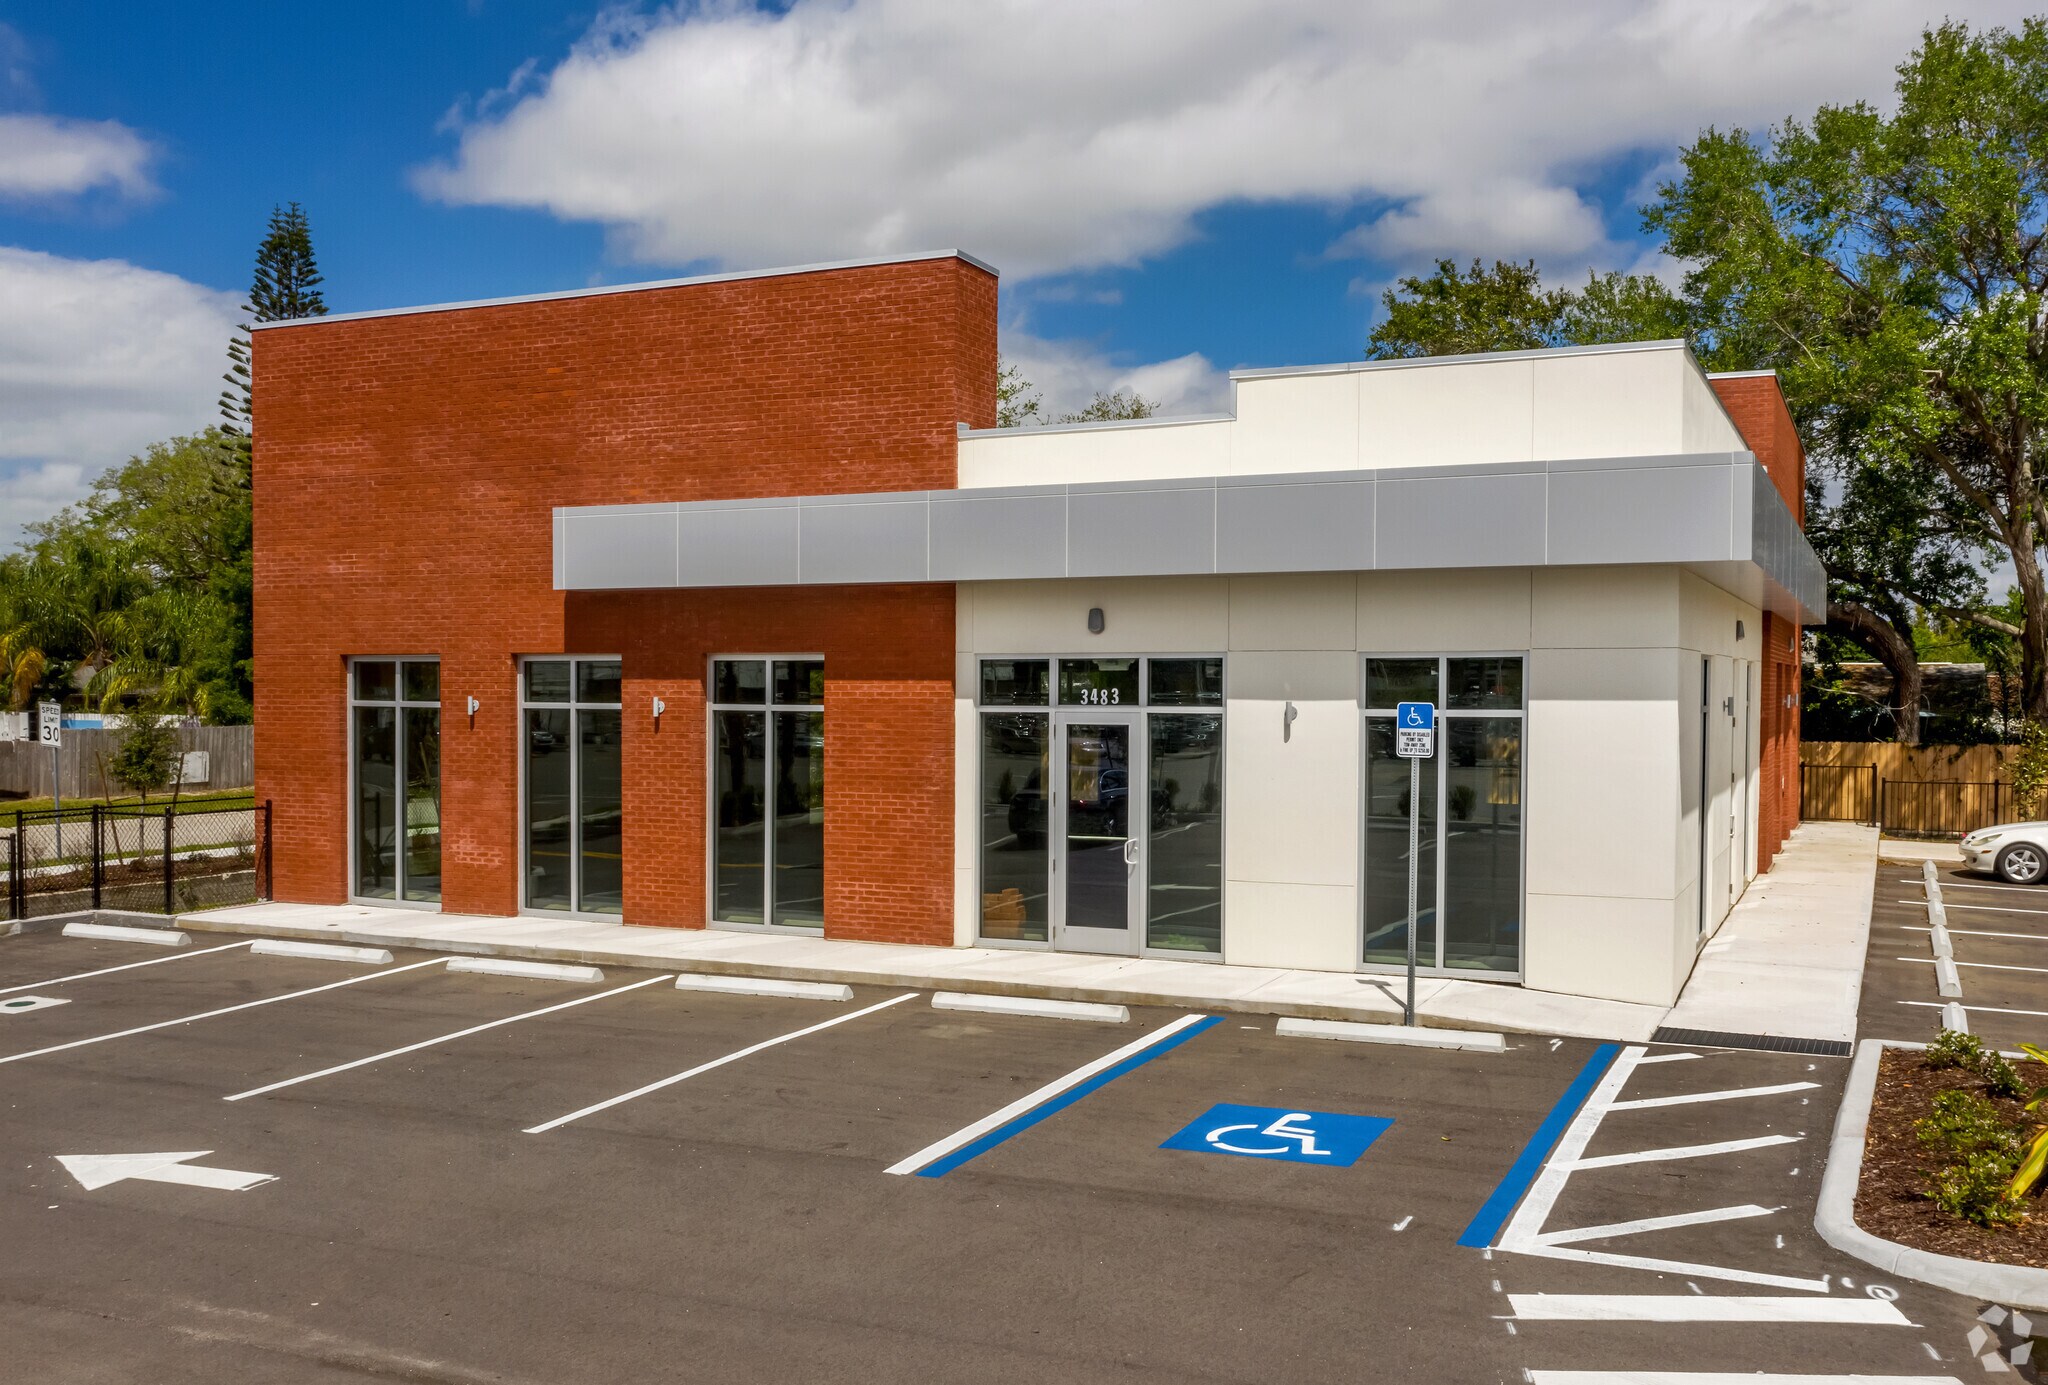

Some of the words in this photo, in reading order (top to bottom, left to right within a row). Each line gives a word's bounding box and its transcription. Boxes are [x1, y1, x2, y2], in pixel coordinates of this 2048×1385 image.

[1080, 688, 1119, 705] 3483
[42, 706, 59, 715] SPEED
[43, 725, 59, 742] 30
